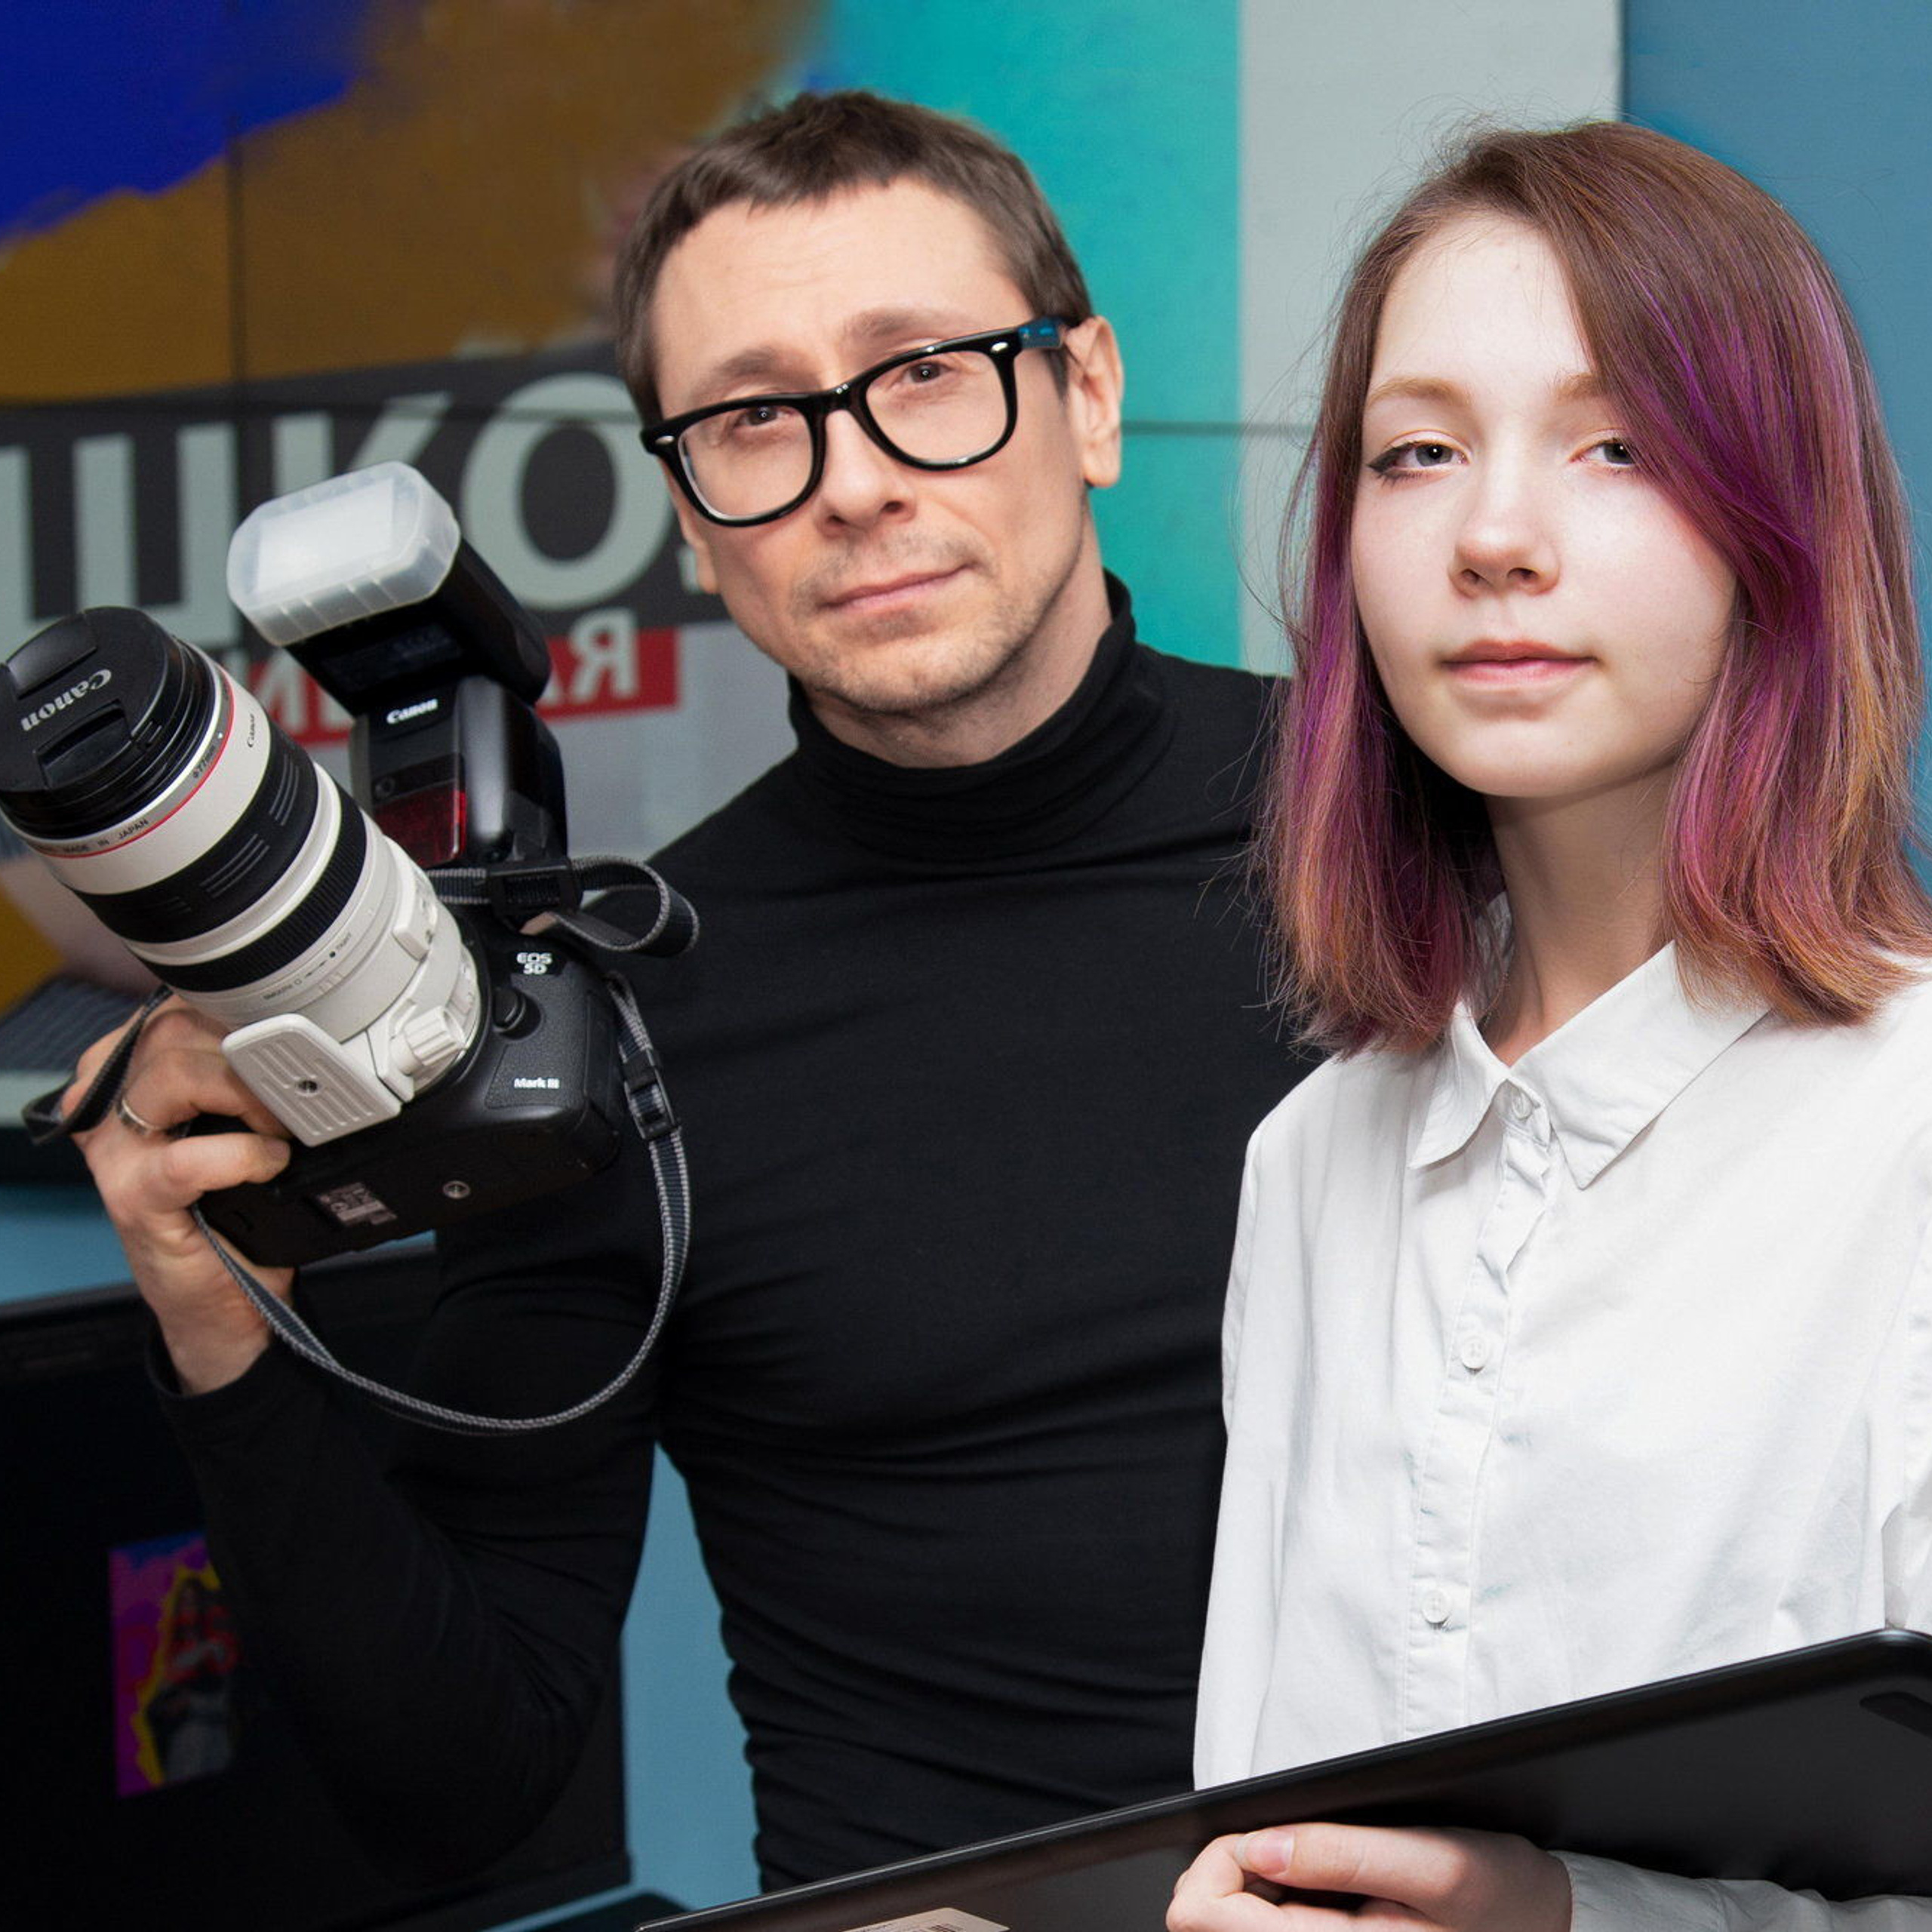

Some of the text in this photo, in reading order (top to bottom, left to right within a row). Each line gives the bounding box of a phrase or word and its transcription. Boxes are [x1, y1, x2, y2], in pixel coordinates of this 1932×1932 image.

[20, 668, 112, 732] Canon
[386, 698, 438, 724] Canon
[118, 819, 149, 839] JAPAN
[515, 952, 552, 964] EOS
[523, 964, 547, 975] 5D
[513, 1077, 546, 1089] Mark
